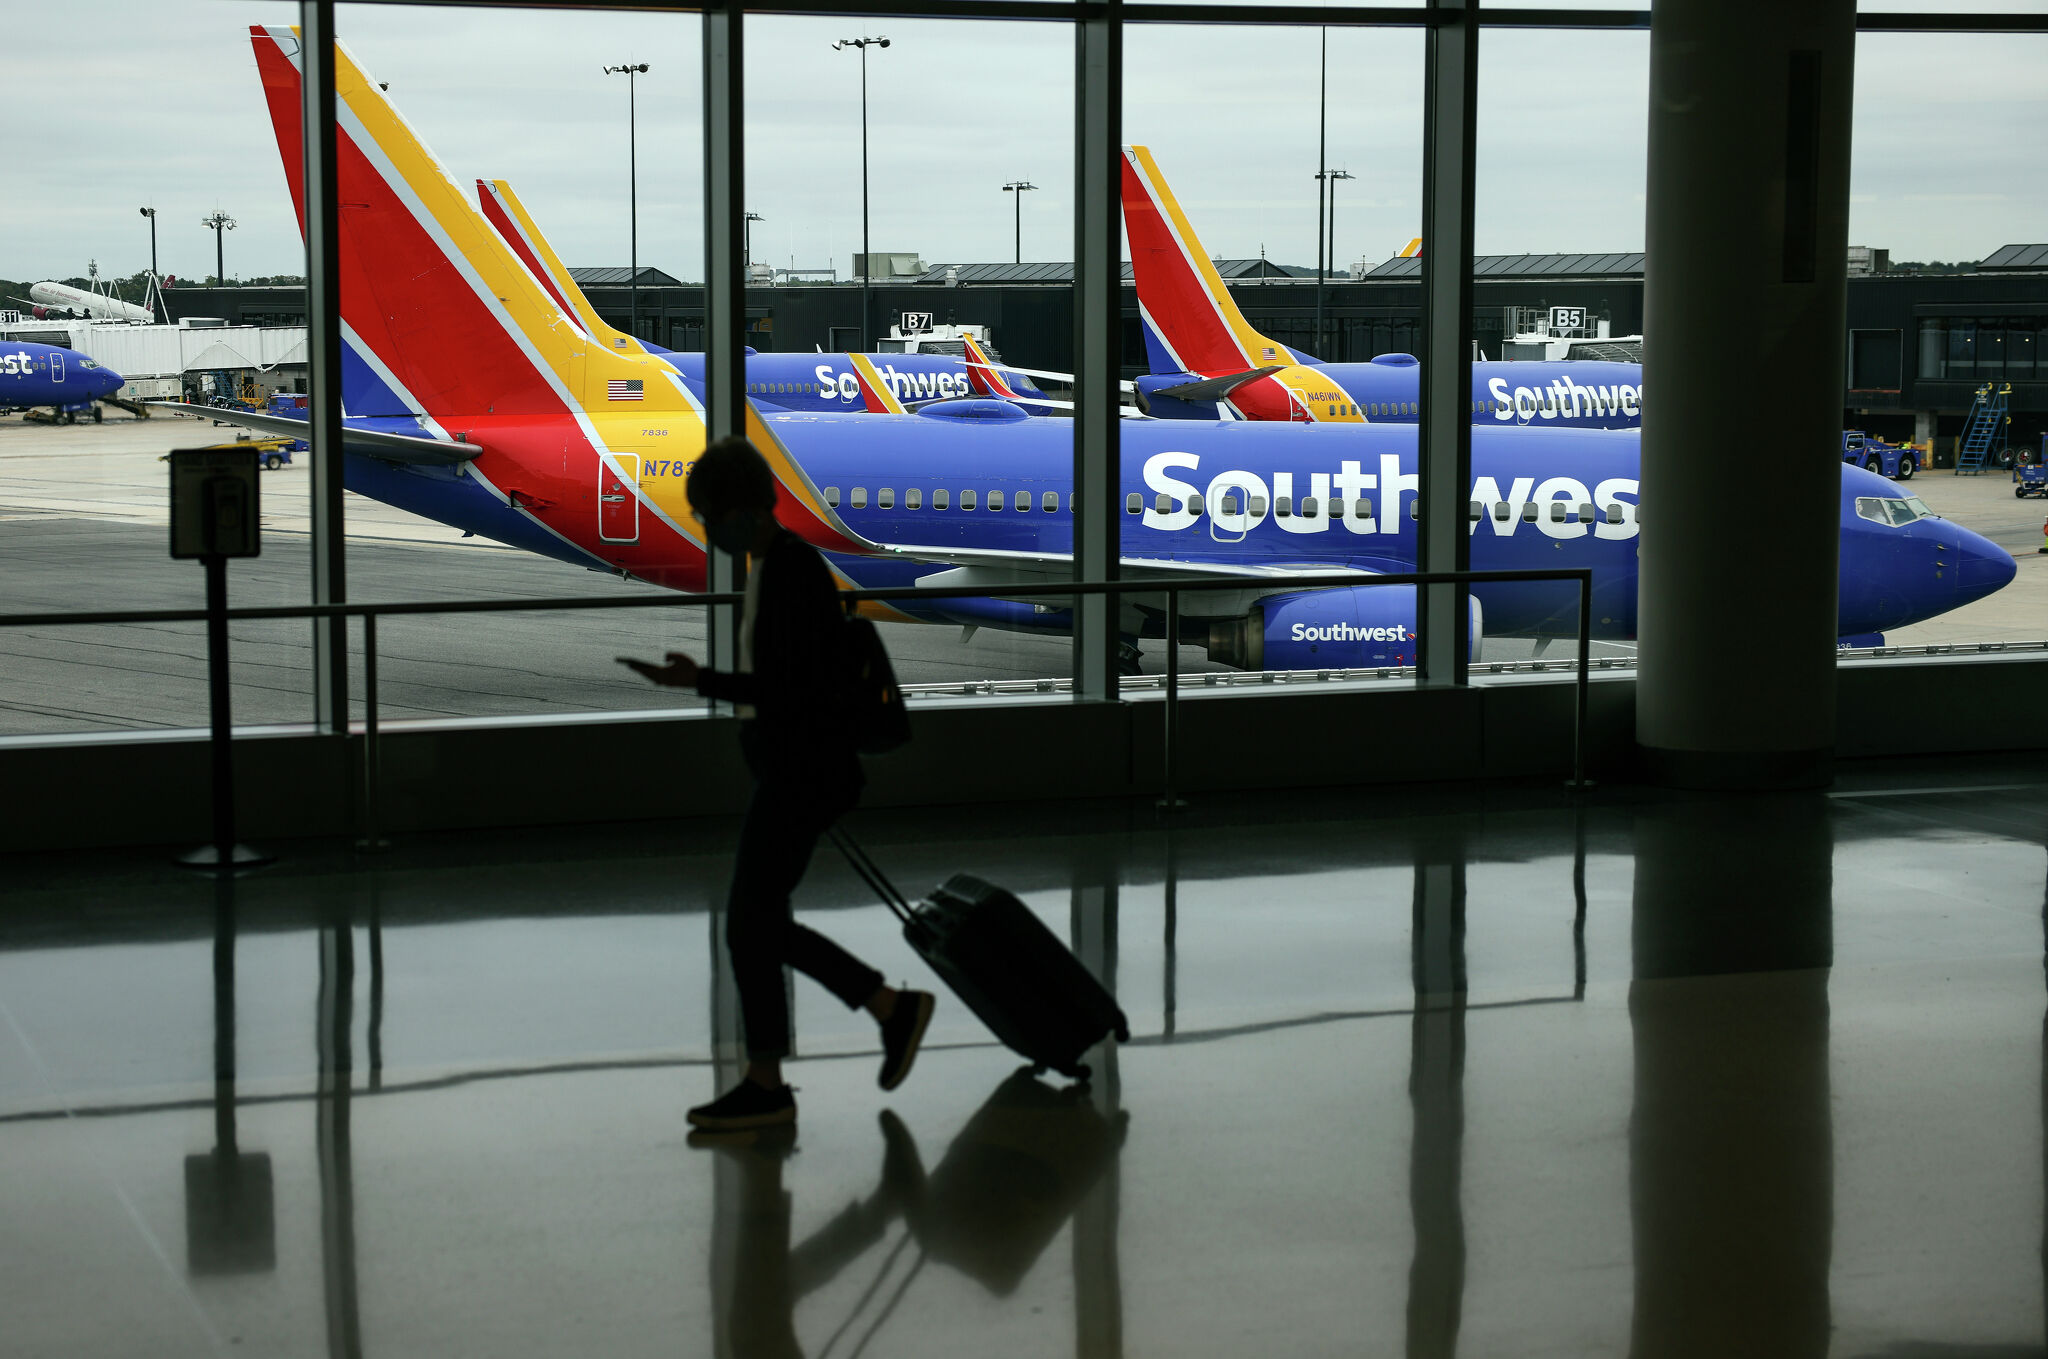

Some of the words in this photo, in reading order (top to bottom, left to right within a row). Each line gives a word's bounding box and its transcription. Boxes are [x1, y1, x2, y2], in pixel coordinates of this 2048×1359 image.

[0, 311, 17, 323] B11
[908, 314, 929, 329] B7
[1556, 309, 1581, 327] B5
[815, 365, 969, 399] Sothwes
[1307, 392, 1341, 402] N461WN
[1488, 375, 1642, 421] Southwe
[641, 429, 668, 437] 7836
[644, 460, 697, 477] N783
[1142, 452, 1641, 540] Southwes
[1291, 622, 1407, 642] Southwest
